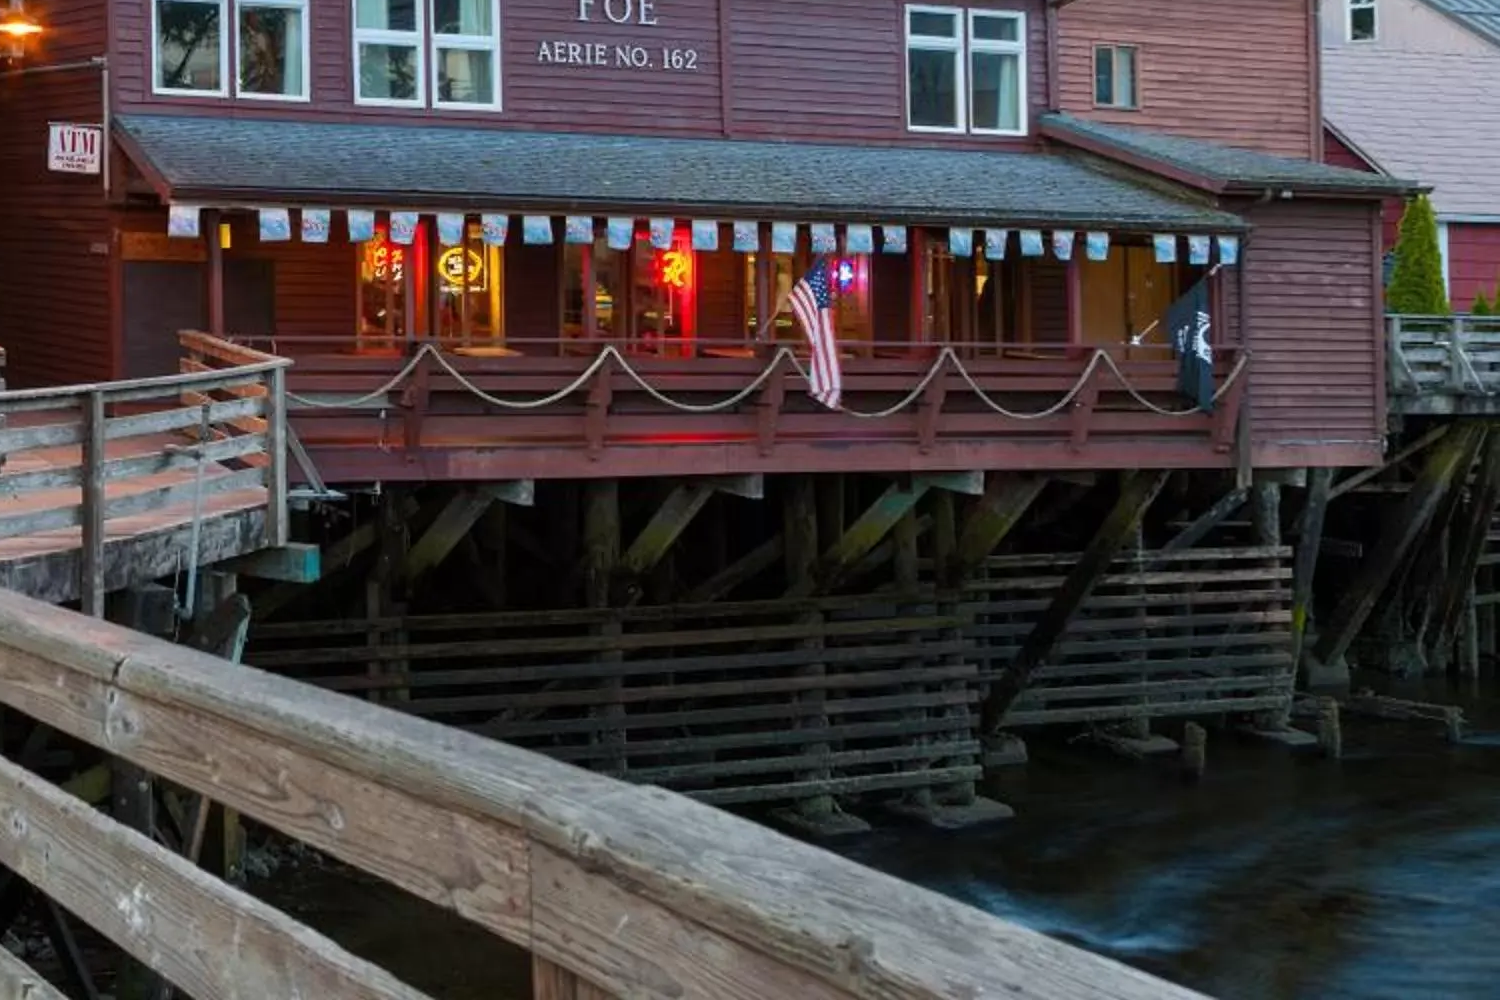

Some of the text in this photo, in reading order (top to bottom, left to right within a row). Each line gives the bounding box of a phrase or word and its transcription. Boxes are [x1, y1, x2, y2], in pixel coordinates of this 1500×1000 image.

[537, 40, 699, 70] AERIE NO. 162
